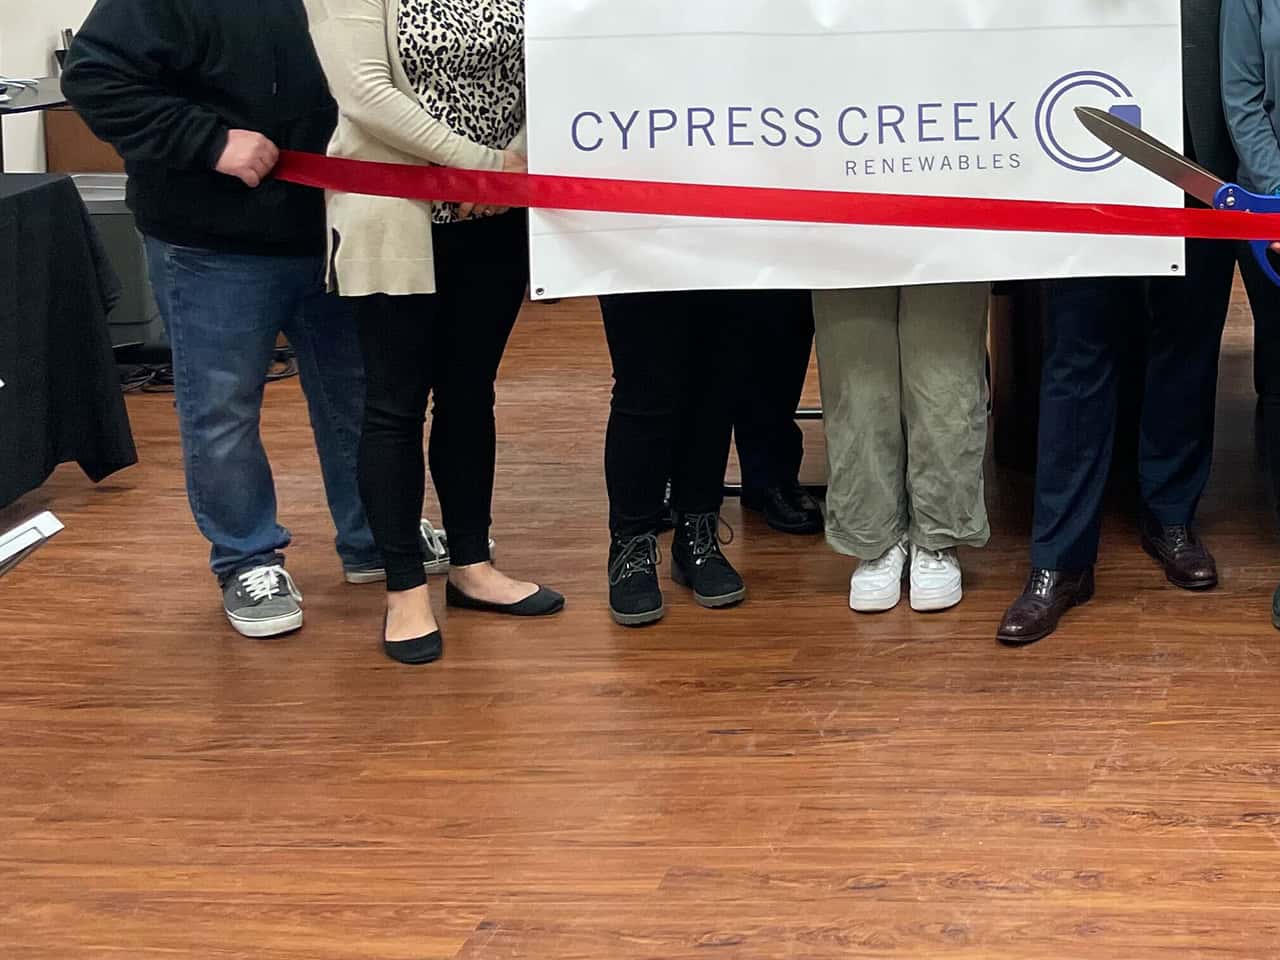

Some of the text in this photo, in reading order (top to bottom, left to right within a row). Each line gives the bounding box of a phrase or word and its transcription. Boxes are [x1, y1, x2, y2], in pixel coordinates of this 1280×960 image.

[571, 101, 1019, 152] CYPRESS CREEK
[845, 153, 1021, 177] RENEWABLES
